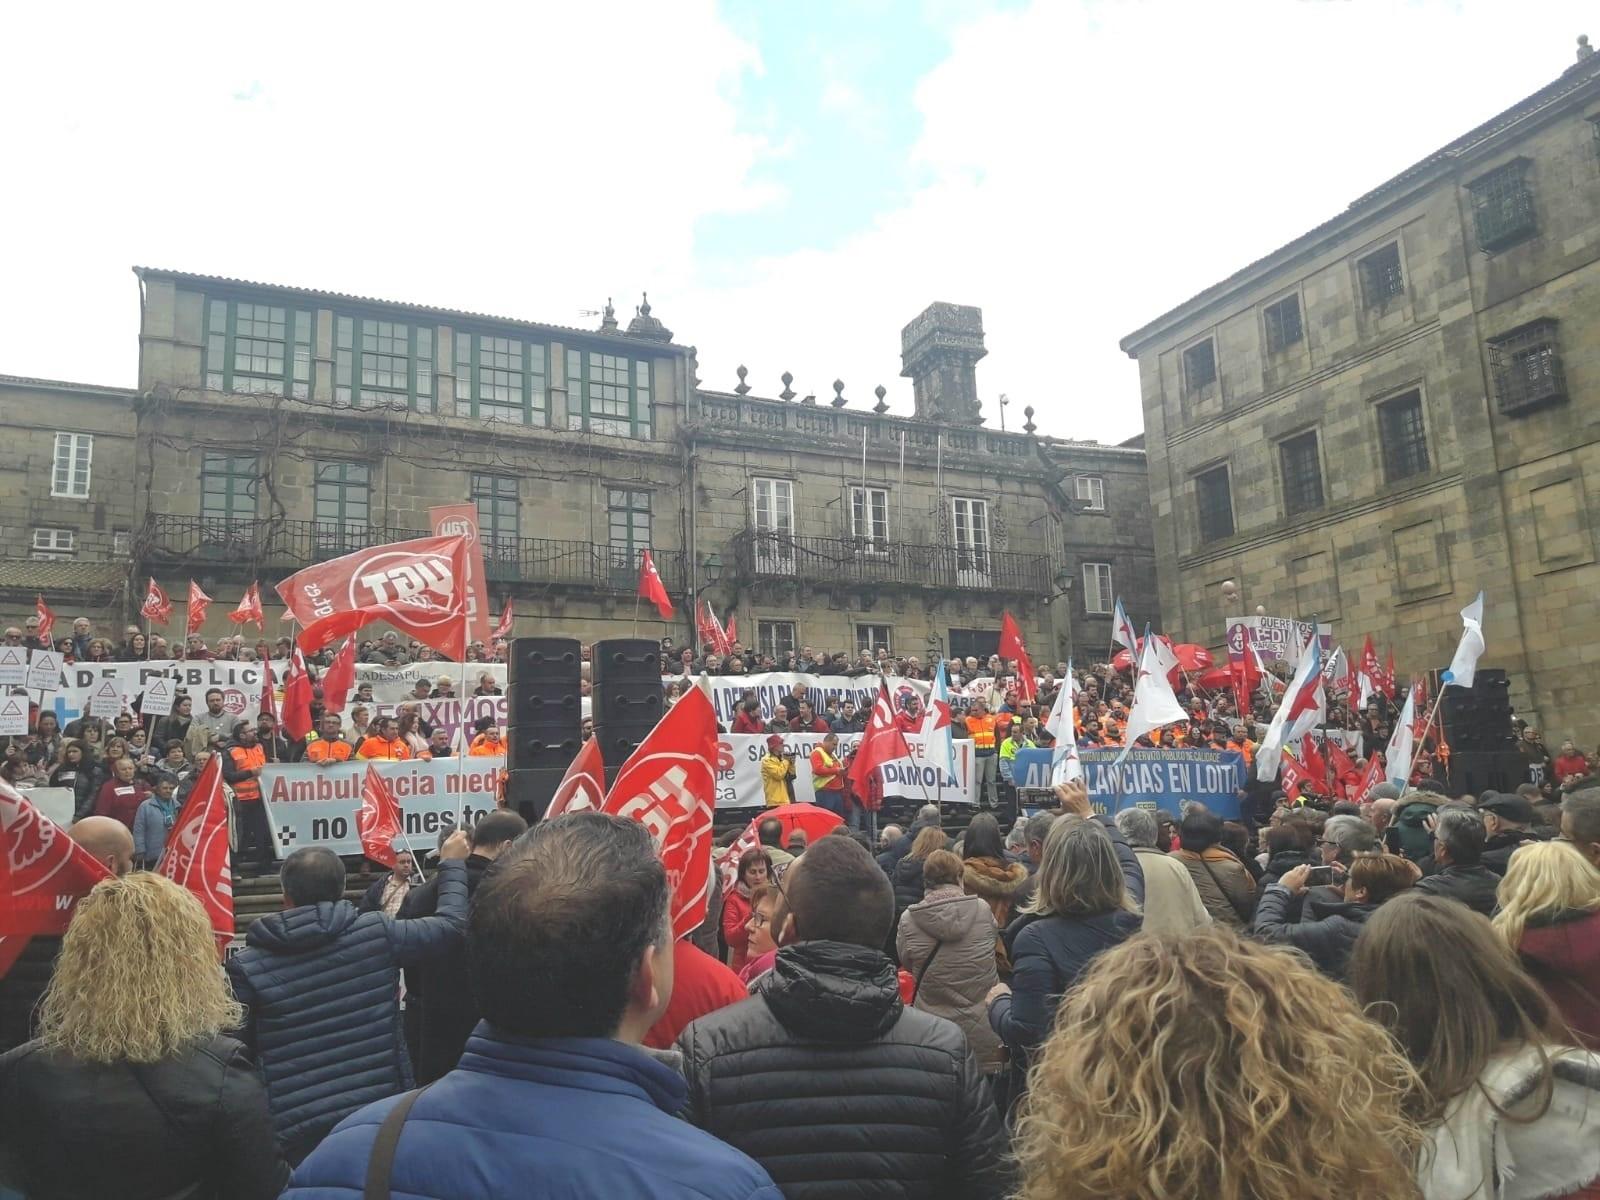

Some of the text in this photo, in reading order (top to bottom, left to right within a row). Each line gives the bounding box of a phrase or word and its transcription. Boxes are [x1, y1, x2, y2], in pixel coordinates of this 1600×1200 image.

[1168, 763, 1192, 793] EN
[1196, 764, 1240, 793] LOITA
[313, 815, 347, 840] no
